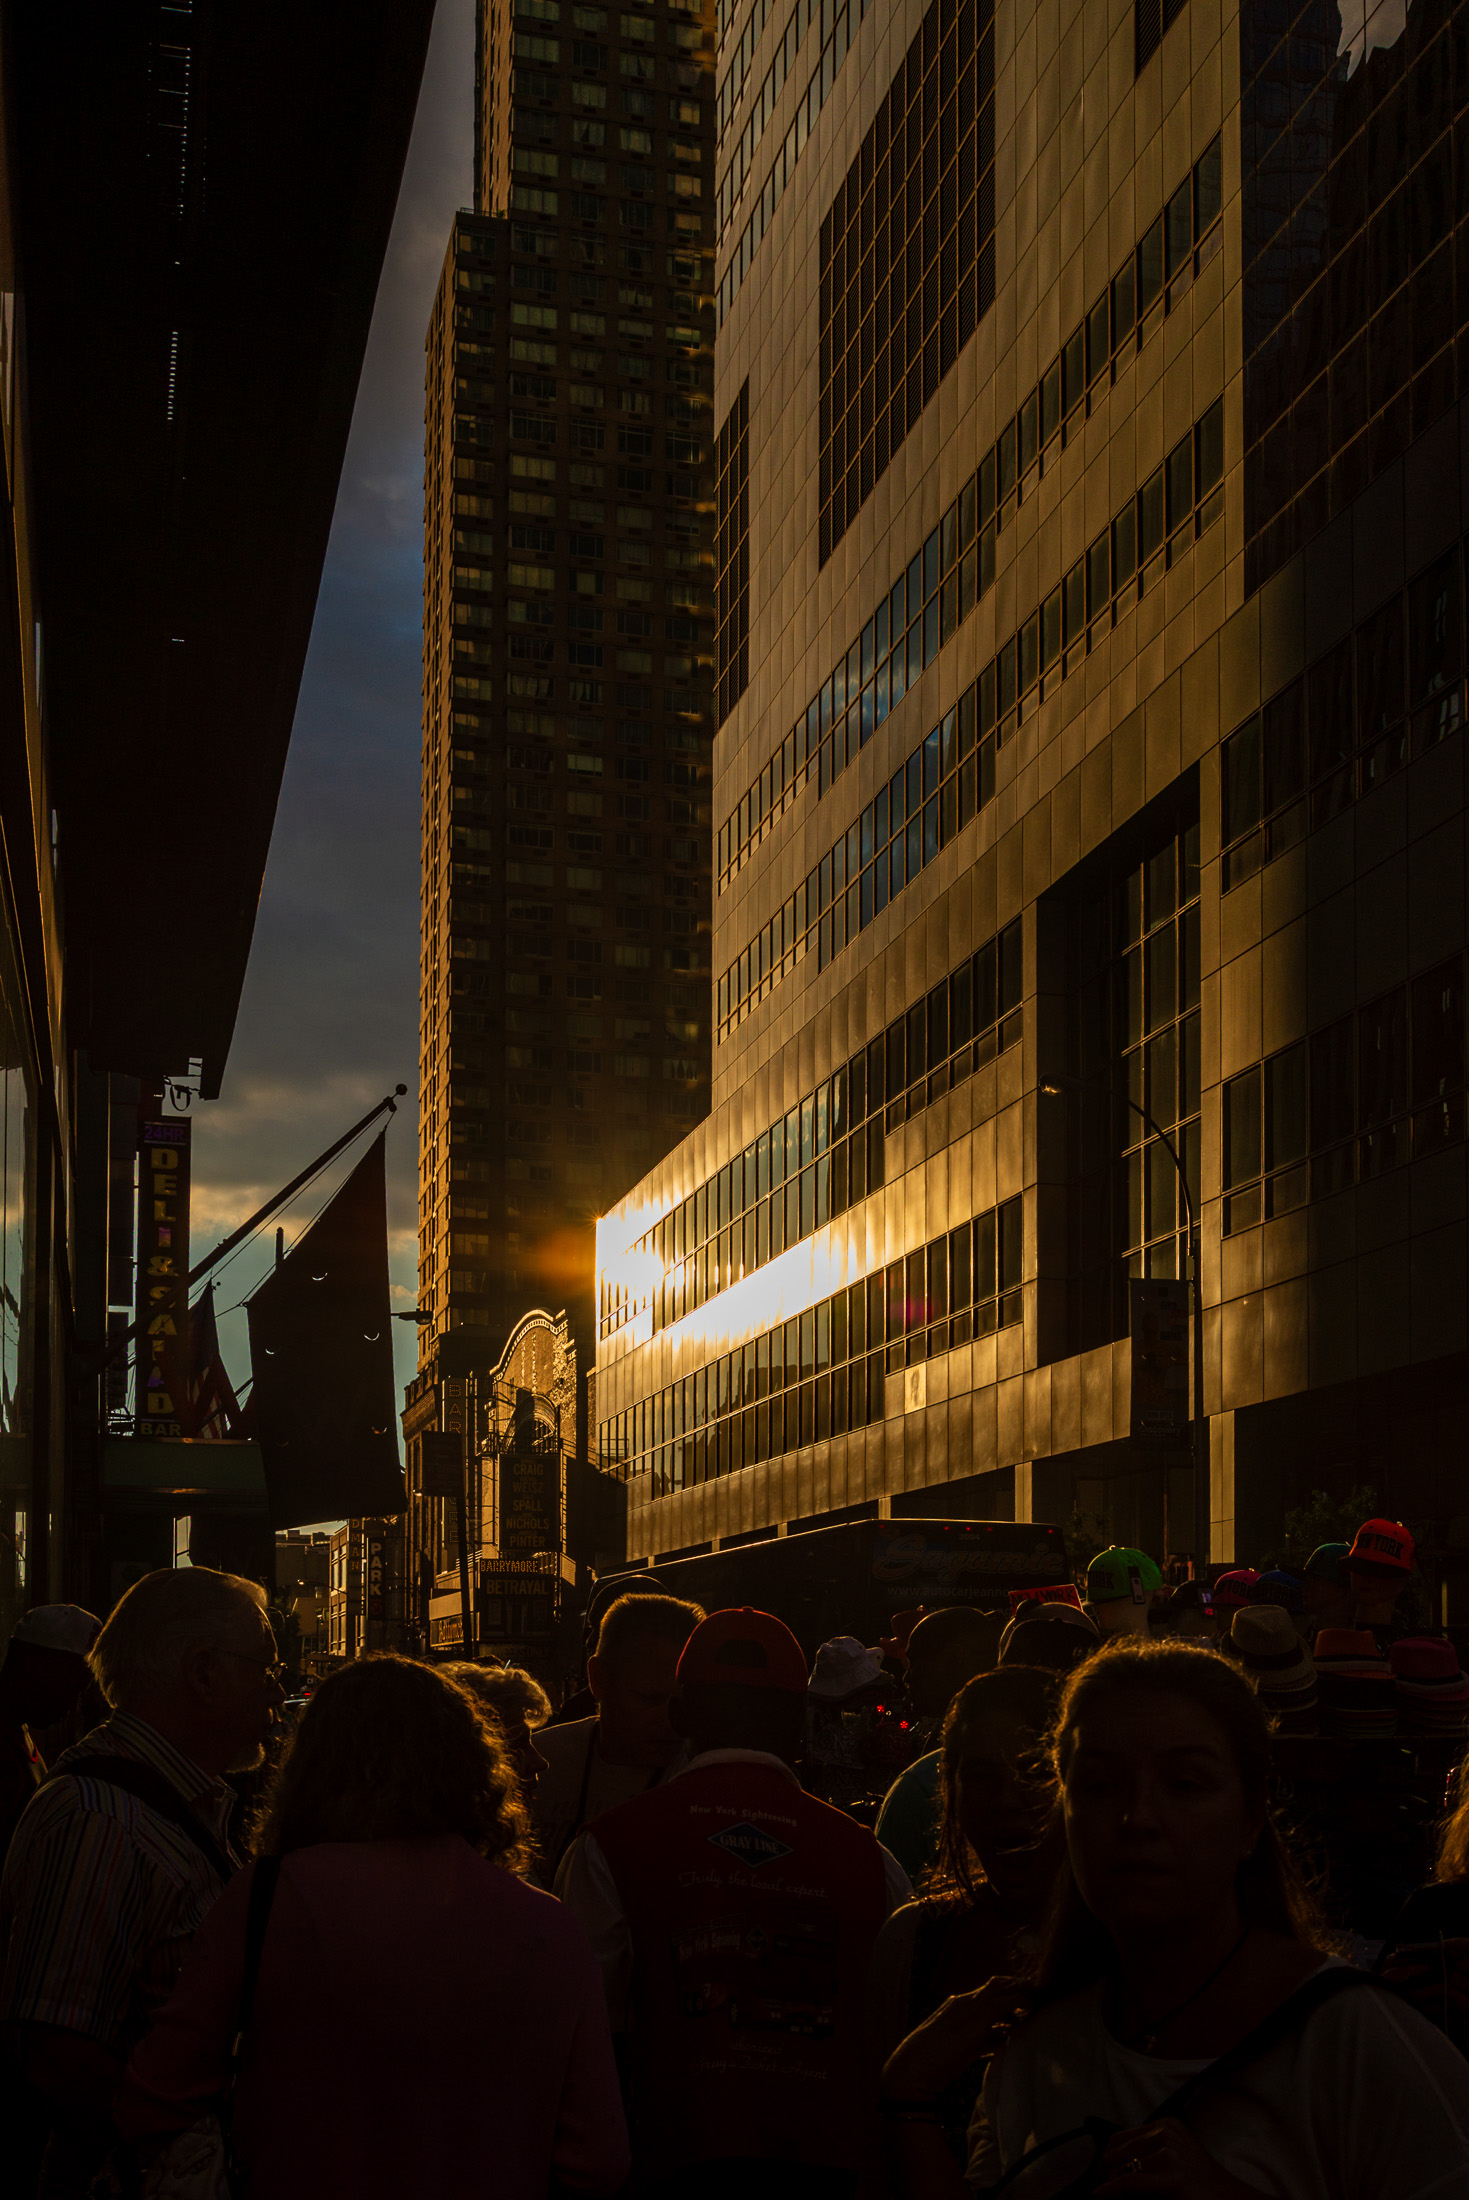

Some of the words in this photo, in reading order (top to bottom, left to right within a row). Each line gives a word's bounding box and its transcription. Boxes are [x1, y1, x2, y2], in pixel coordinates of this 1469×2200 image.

[144, 1125, 184, 1142] 24HR
[140, 1422, 182, 1436] BAR
[513, 1463, 544, 1476] CRAIG
[512, 1481, 544, 1494] WEISZ
[512, 1499, 543, 1512] SPALL
[505, 1517, 550, 1530] NICHOLS
[509, 1535, 546, 1547] PINTER
[1374, 1533, 1405, 1560] YORK
[480, 1560, 538, 1573] BARRYMORE
[872, 1534, 1065, 1585] Sagamie
[370, 1542, 383, 1596] PARK
[486, 1579, 549, 1595] BETRAYAL
[690, 1804, 712, 1815] New
[715, 1805, 737, 1817] York
[720, 1834, 751, 1849] GRAY
[754, 1837, 780, 1854] LINE
[729, 1870, 747, 1886] the
[750, 1873, 784, 1892] local
